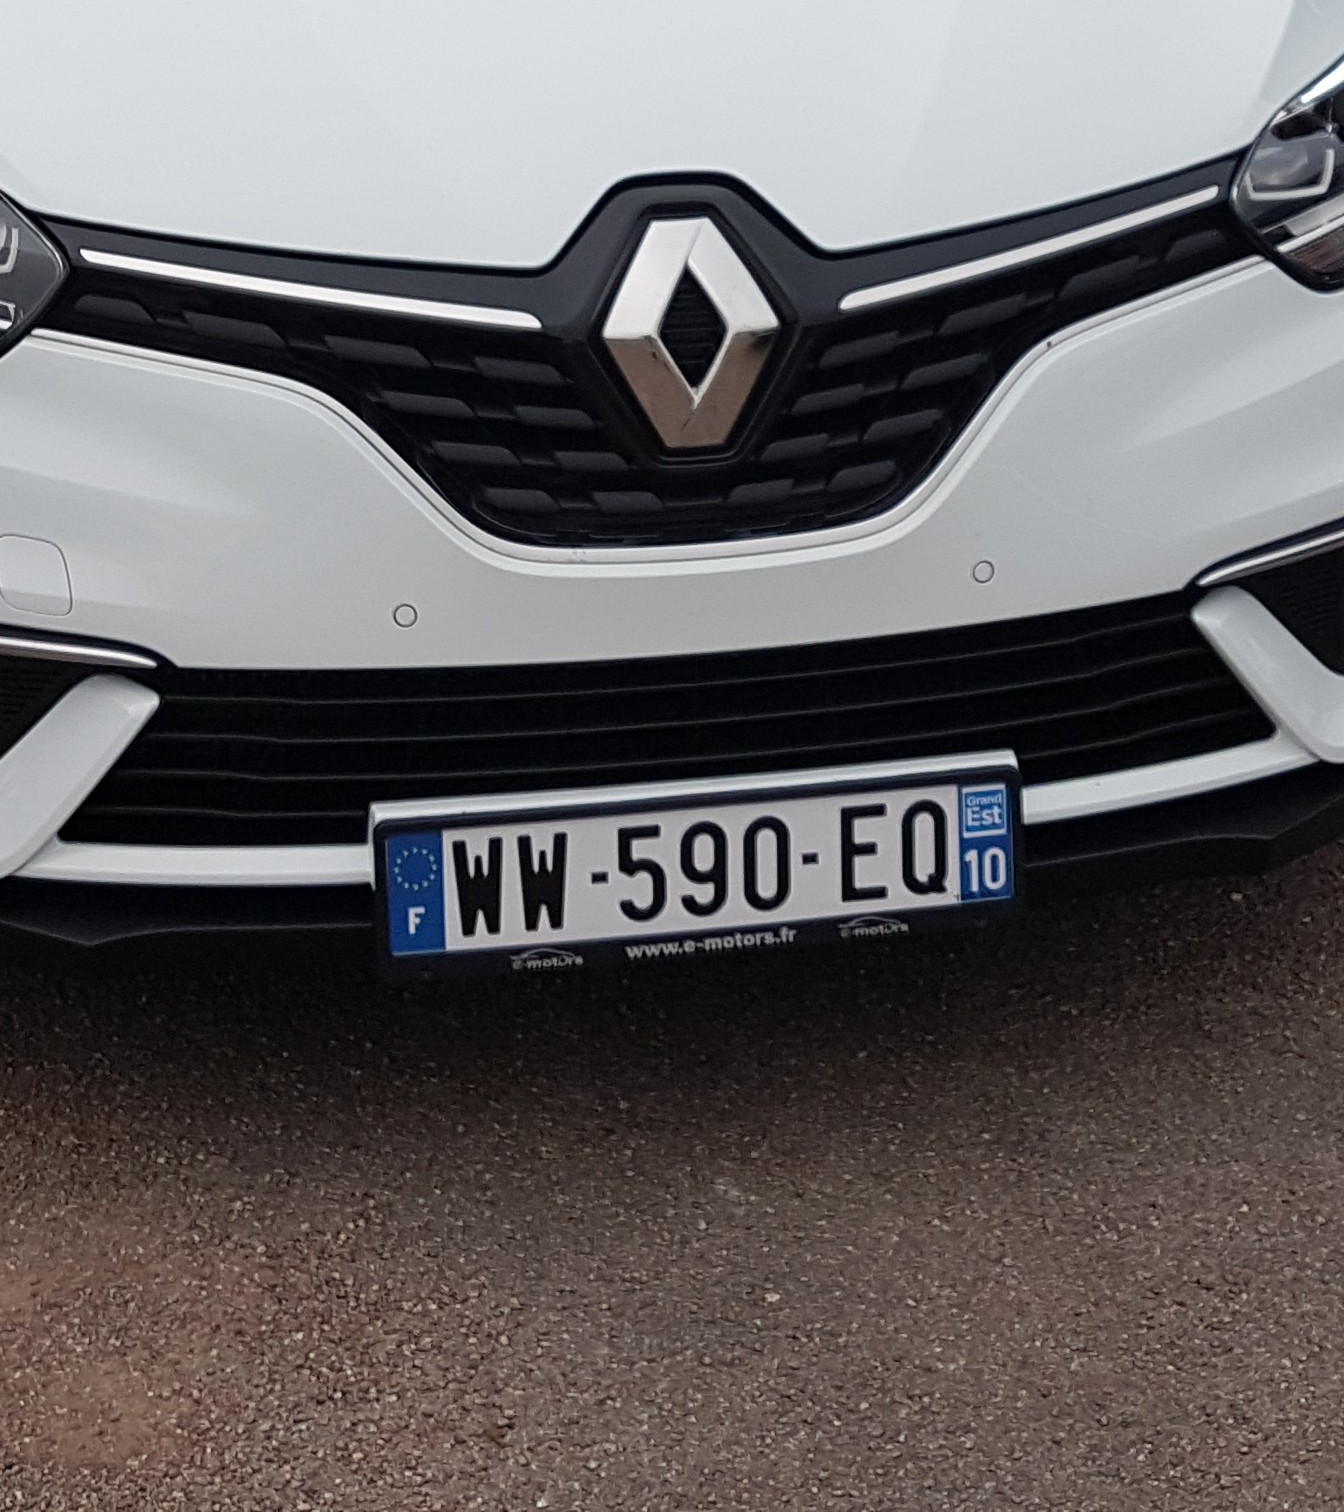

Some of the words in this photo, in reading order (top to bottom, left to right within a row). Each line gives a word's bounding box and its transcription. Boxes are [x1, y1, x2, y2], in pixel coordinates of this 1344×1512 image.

[965, 792, 1003, 807] Grand
[966, 804, 1003, 827] Est
[451, 798, 948, 937] WW-590-EQ
[963, 846, 1007, 893] 10
[407, 906, 426, 935] F
[624, 925, 797, 961] www.e-motors.fr
